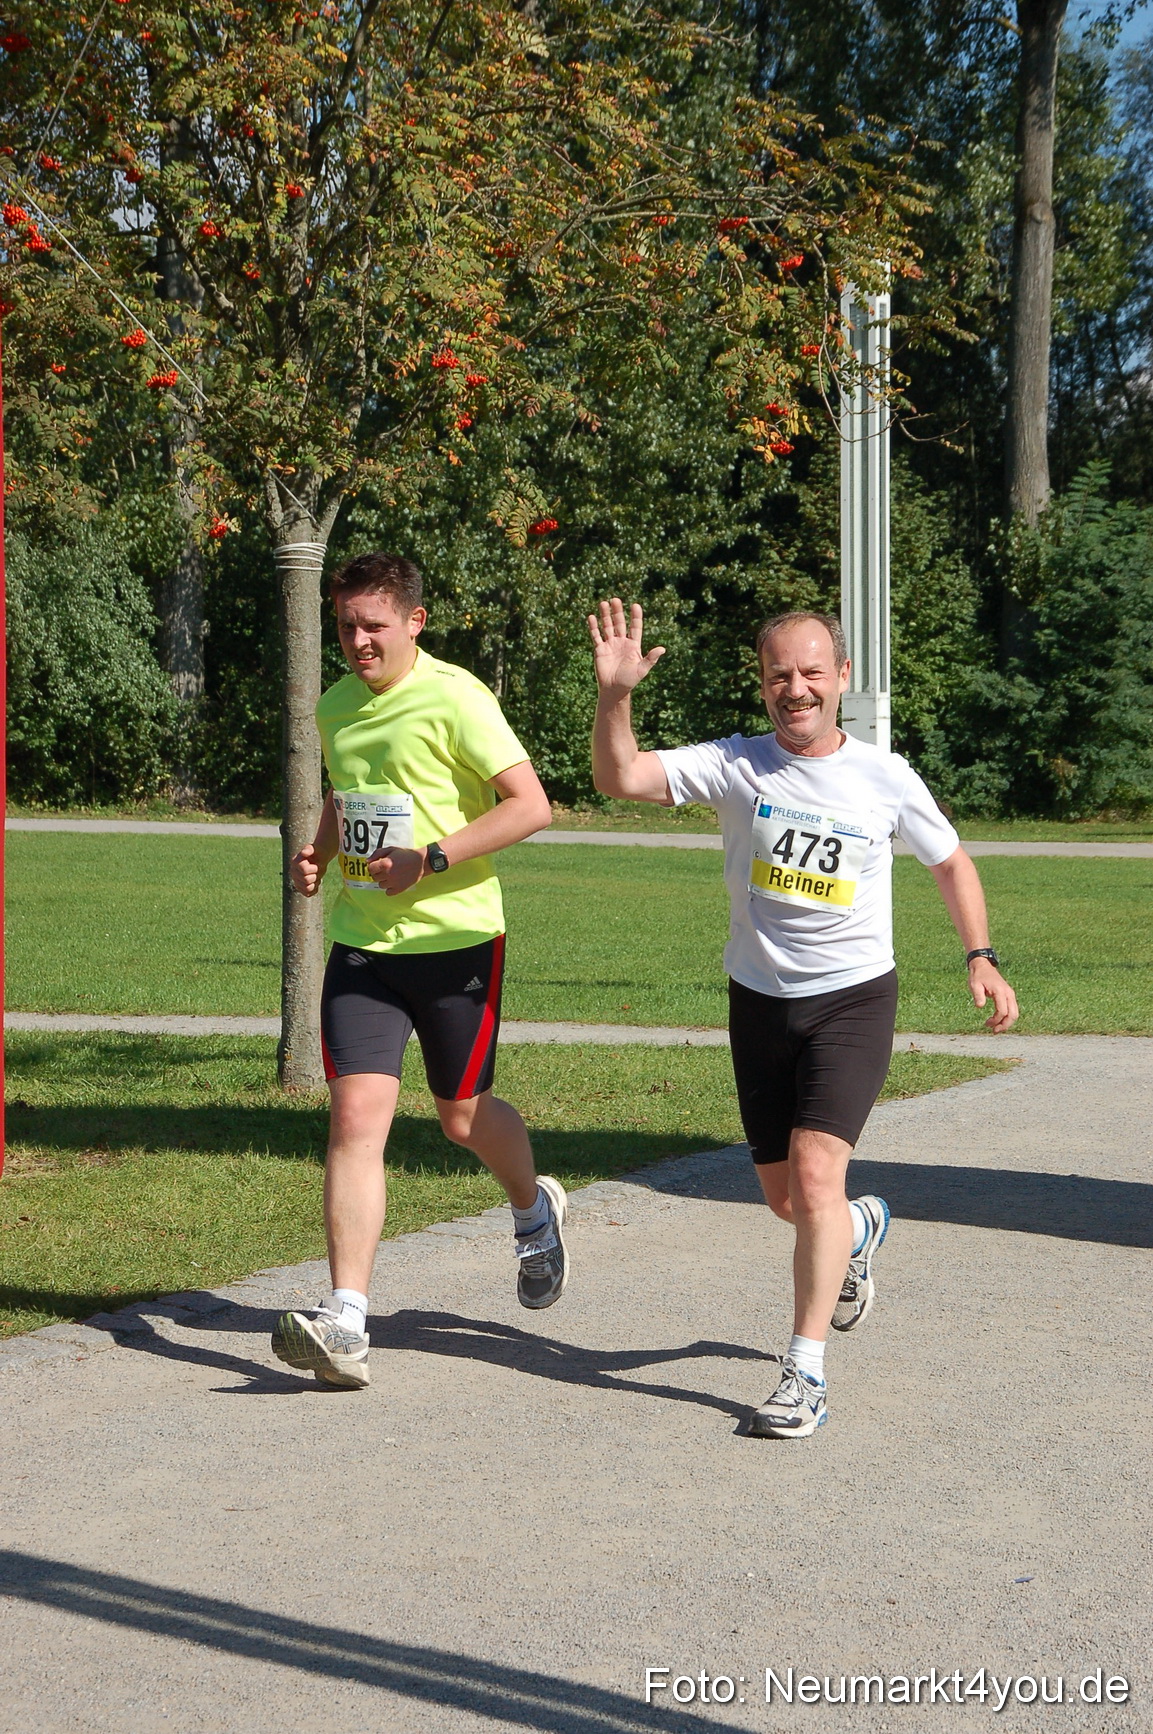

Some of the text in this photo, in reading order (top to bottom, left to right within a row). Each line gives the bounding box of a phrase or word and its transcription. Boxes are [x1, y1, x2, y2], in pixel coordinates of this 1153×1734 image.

[344, 801, 366, 810] DERER
[773, 806, 822, 824] PFLEIDERER
[342, 817, 388, 854] 397
[772, 828, 842, 874] 473
[768, 866, 835, 897] Reiner
